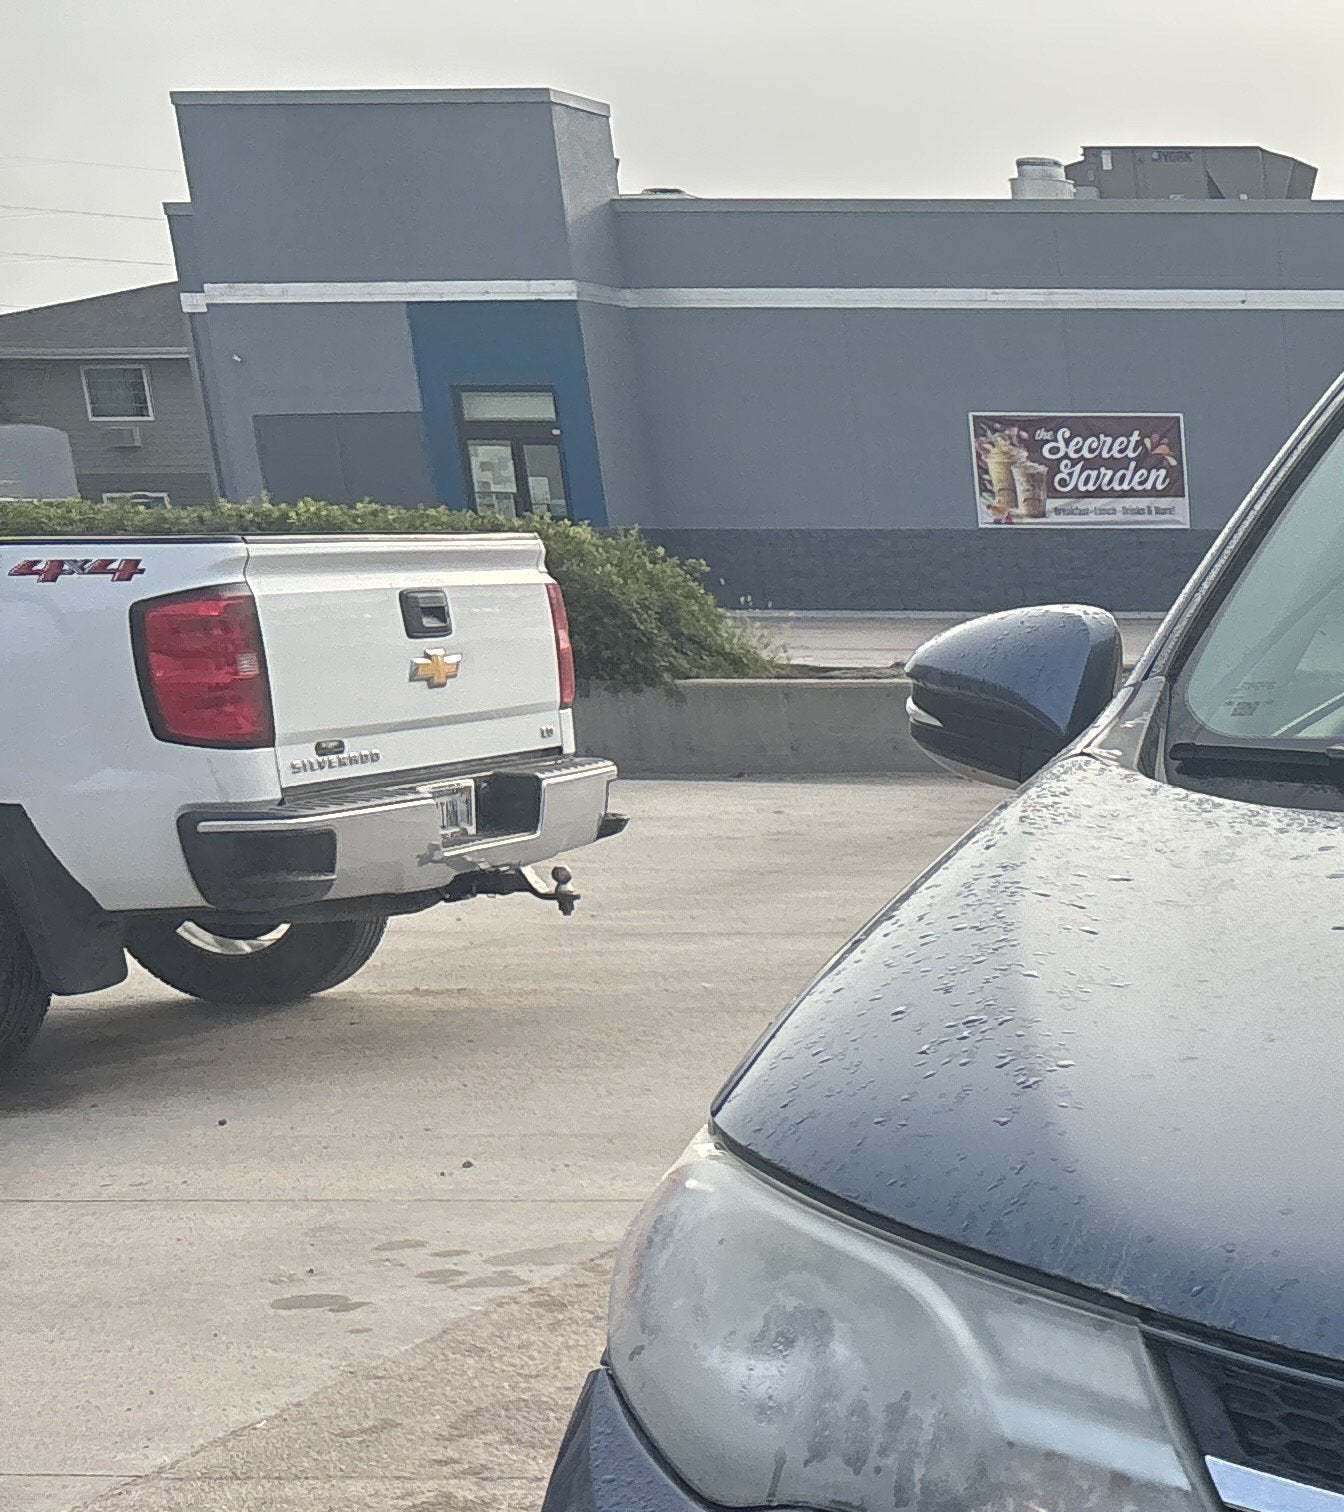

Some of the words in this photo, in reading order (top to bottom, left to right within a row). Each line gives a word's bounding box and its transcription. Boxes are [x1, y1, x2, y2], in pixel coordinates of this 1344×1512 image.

[1035, 428, 1054, 440] the
[1042, 427, 1143, 459] Secret
[1054, 460, 1170, 492] Garden
